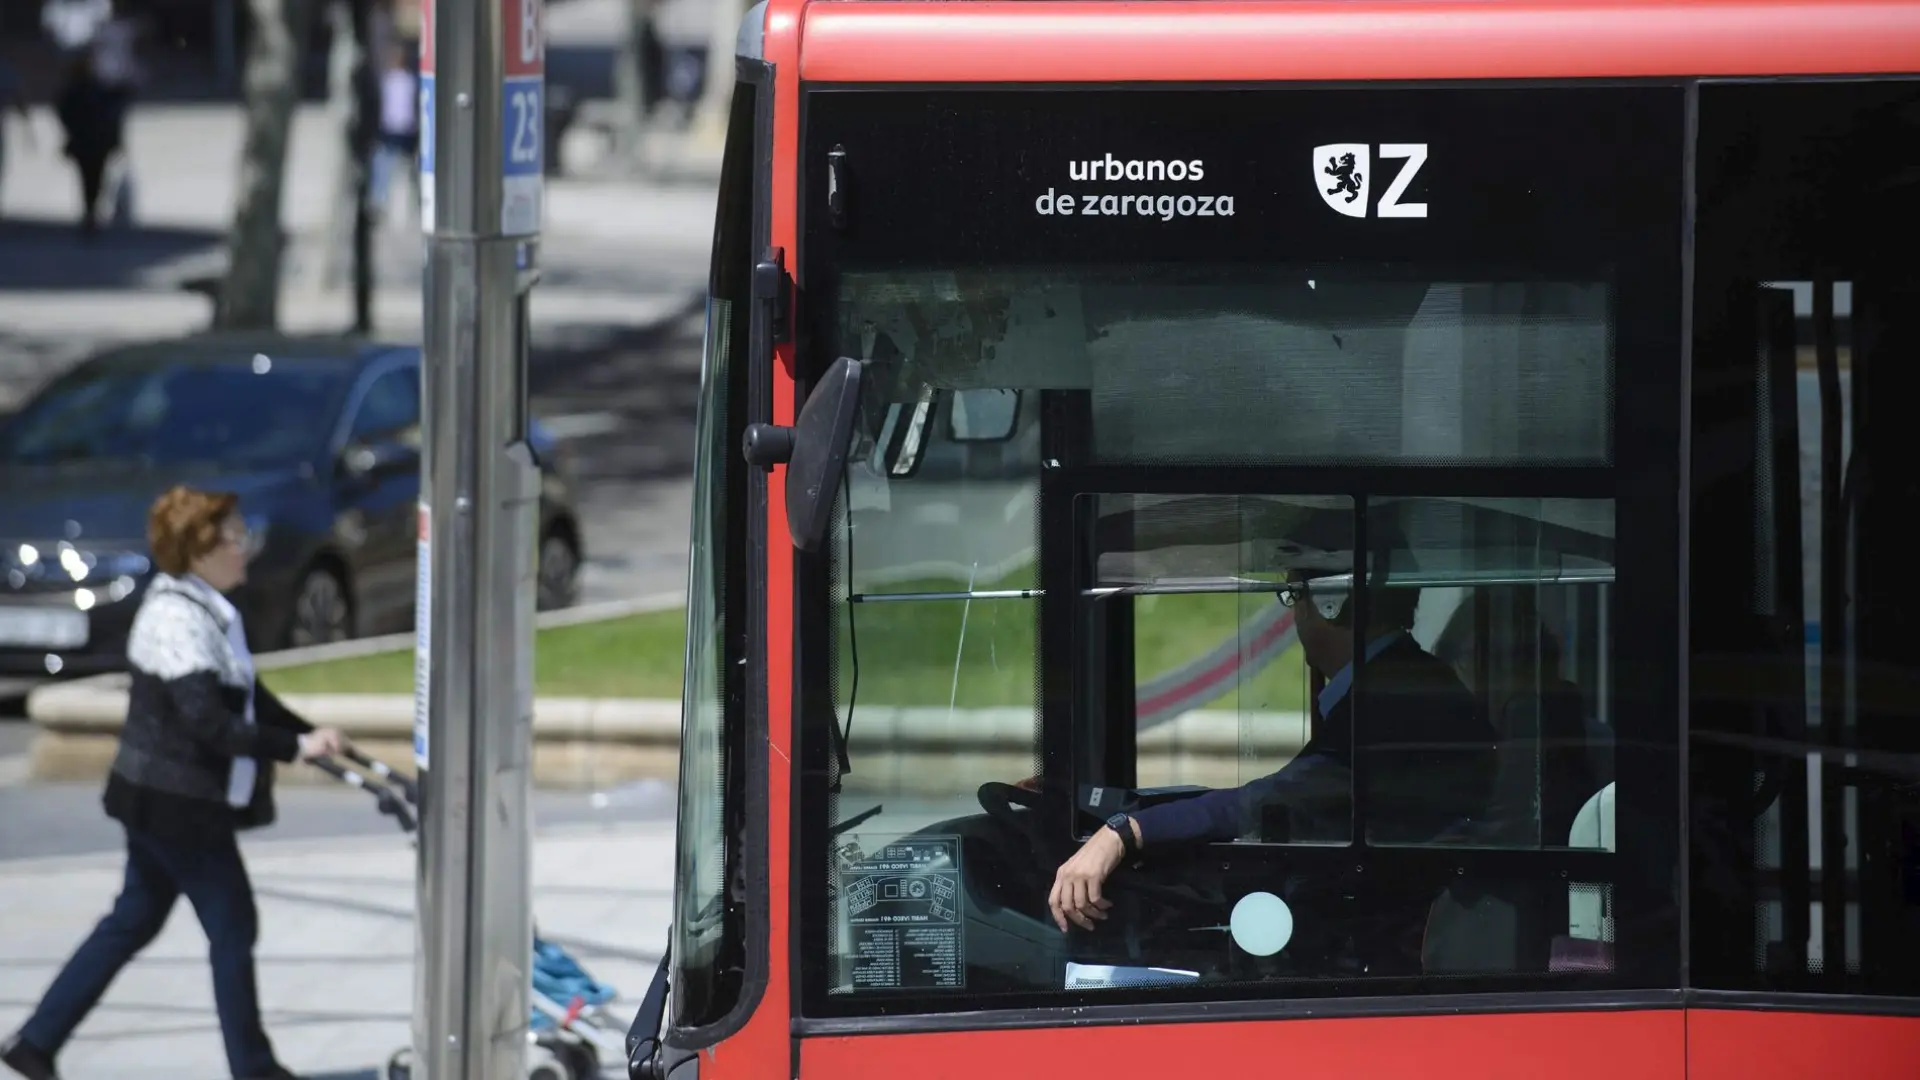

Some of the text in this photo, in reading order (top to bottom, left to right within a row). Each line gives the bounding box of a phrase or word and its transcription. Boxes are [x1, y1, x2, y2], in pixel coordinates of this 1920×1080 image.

[511, 91, 538, 163] 23
[1070, 153, 1205, 182] urbanos
[1377, 143, 1428, 218] Z
[1035, 187, 1236, 222] de zaragoza
